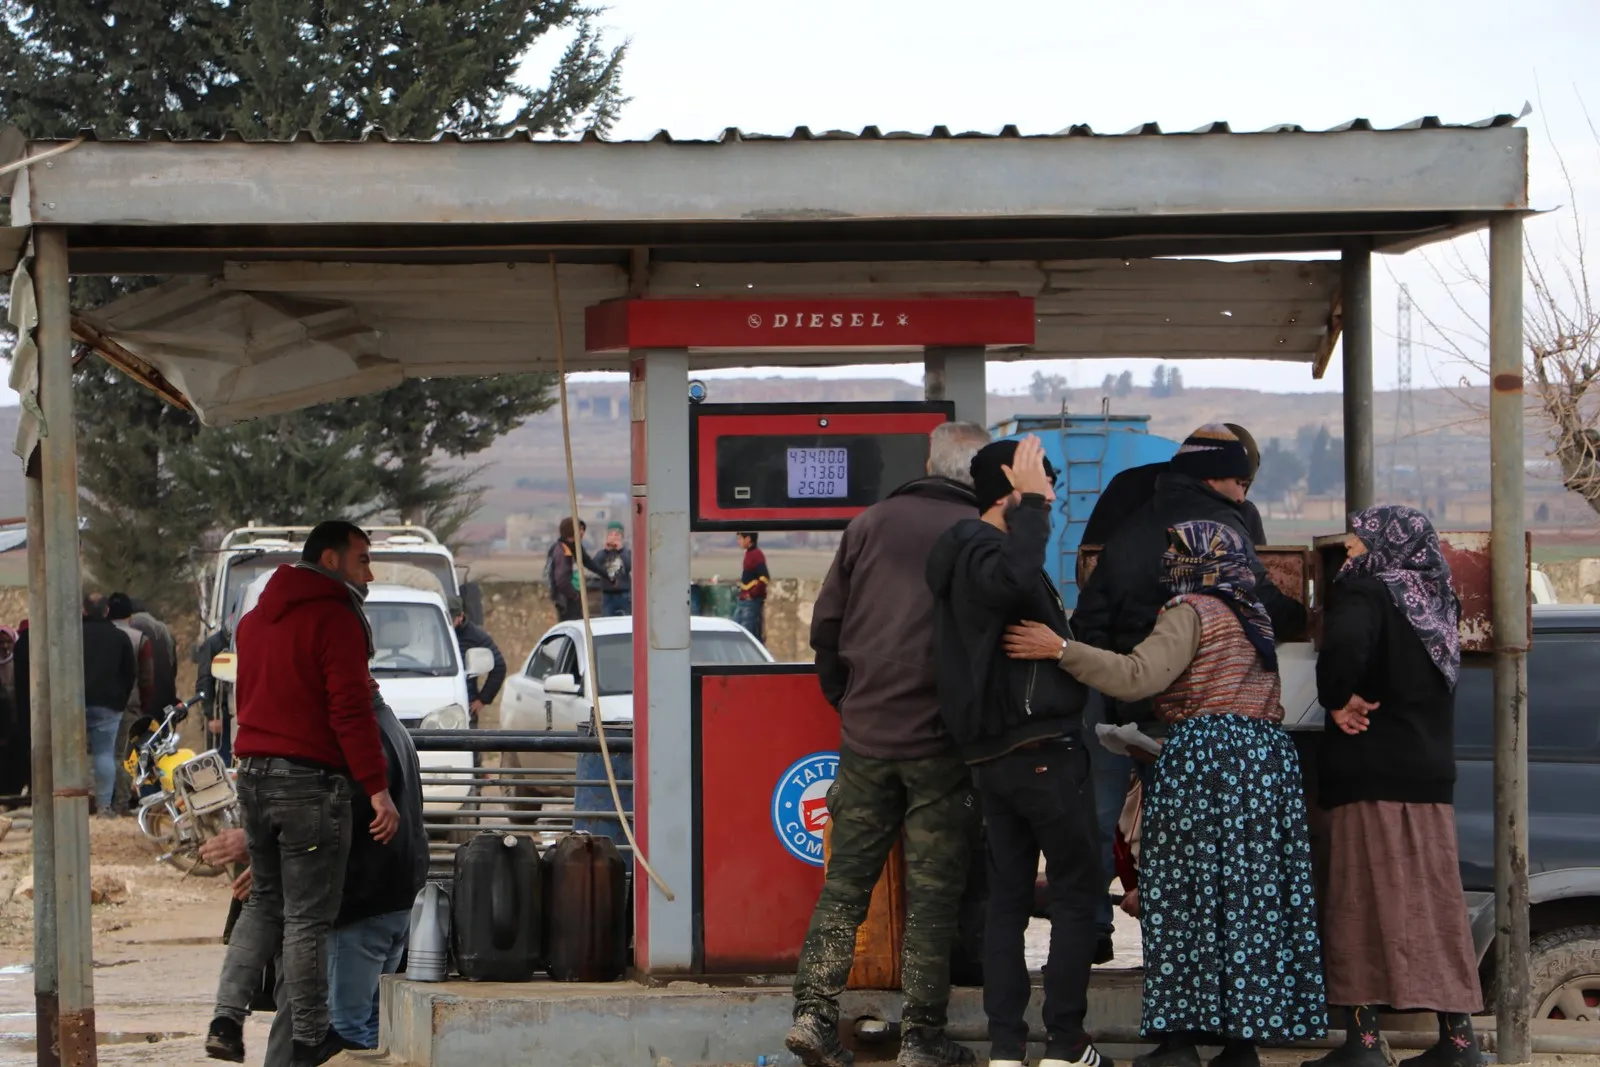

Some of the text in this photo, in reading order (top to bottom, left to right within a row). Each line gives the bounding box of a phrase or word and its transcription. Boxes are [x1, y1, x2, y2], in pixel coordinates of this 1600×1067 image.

[773, 313, 884, 328] DIESEL
[792, 762, 839, 788] TATT
[786, 821, 823, 856] COM
